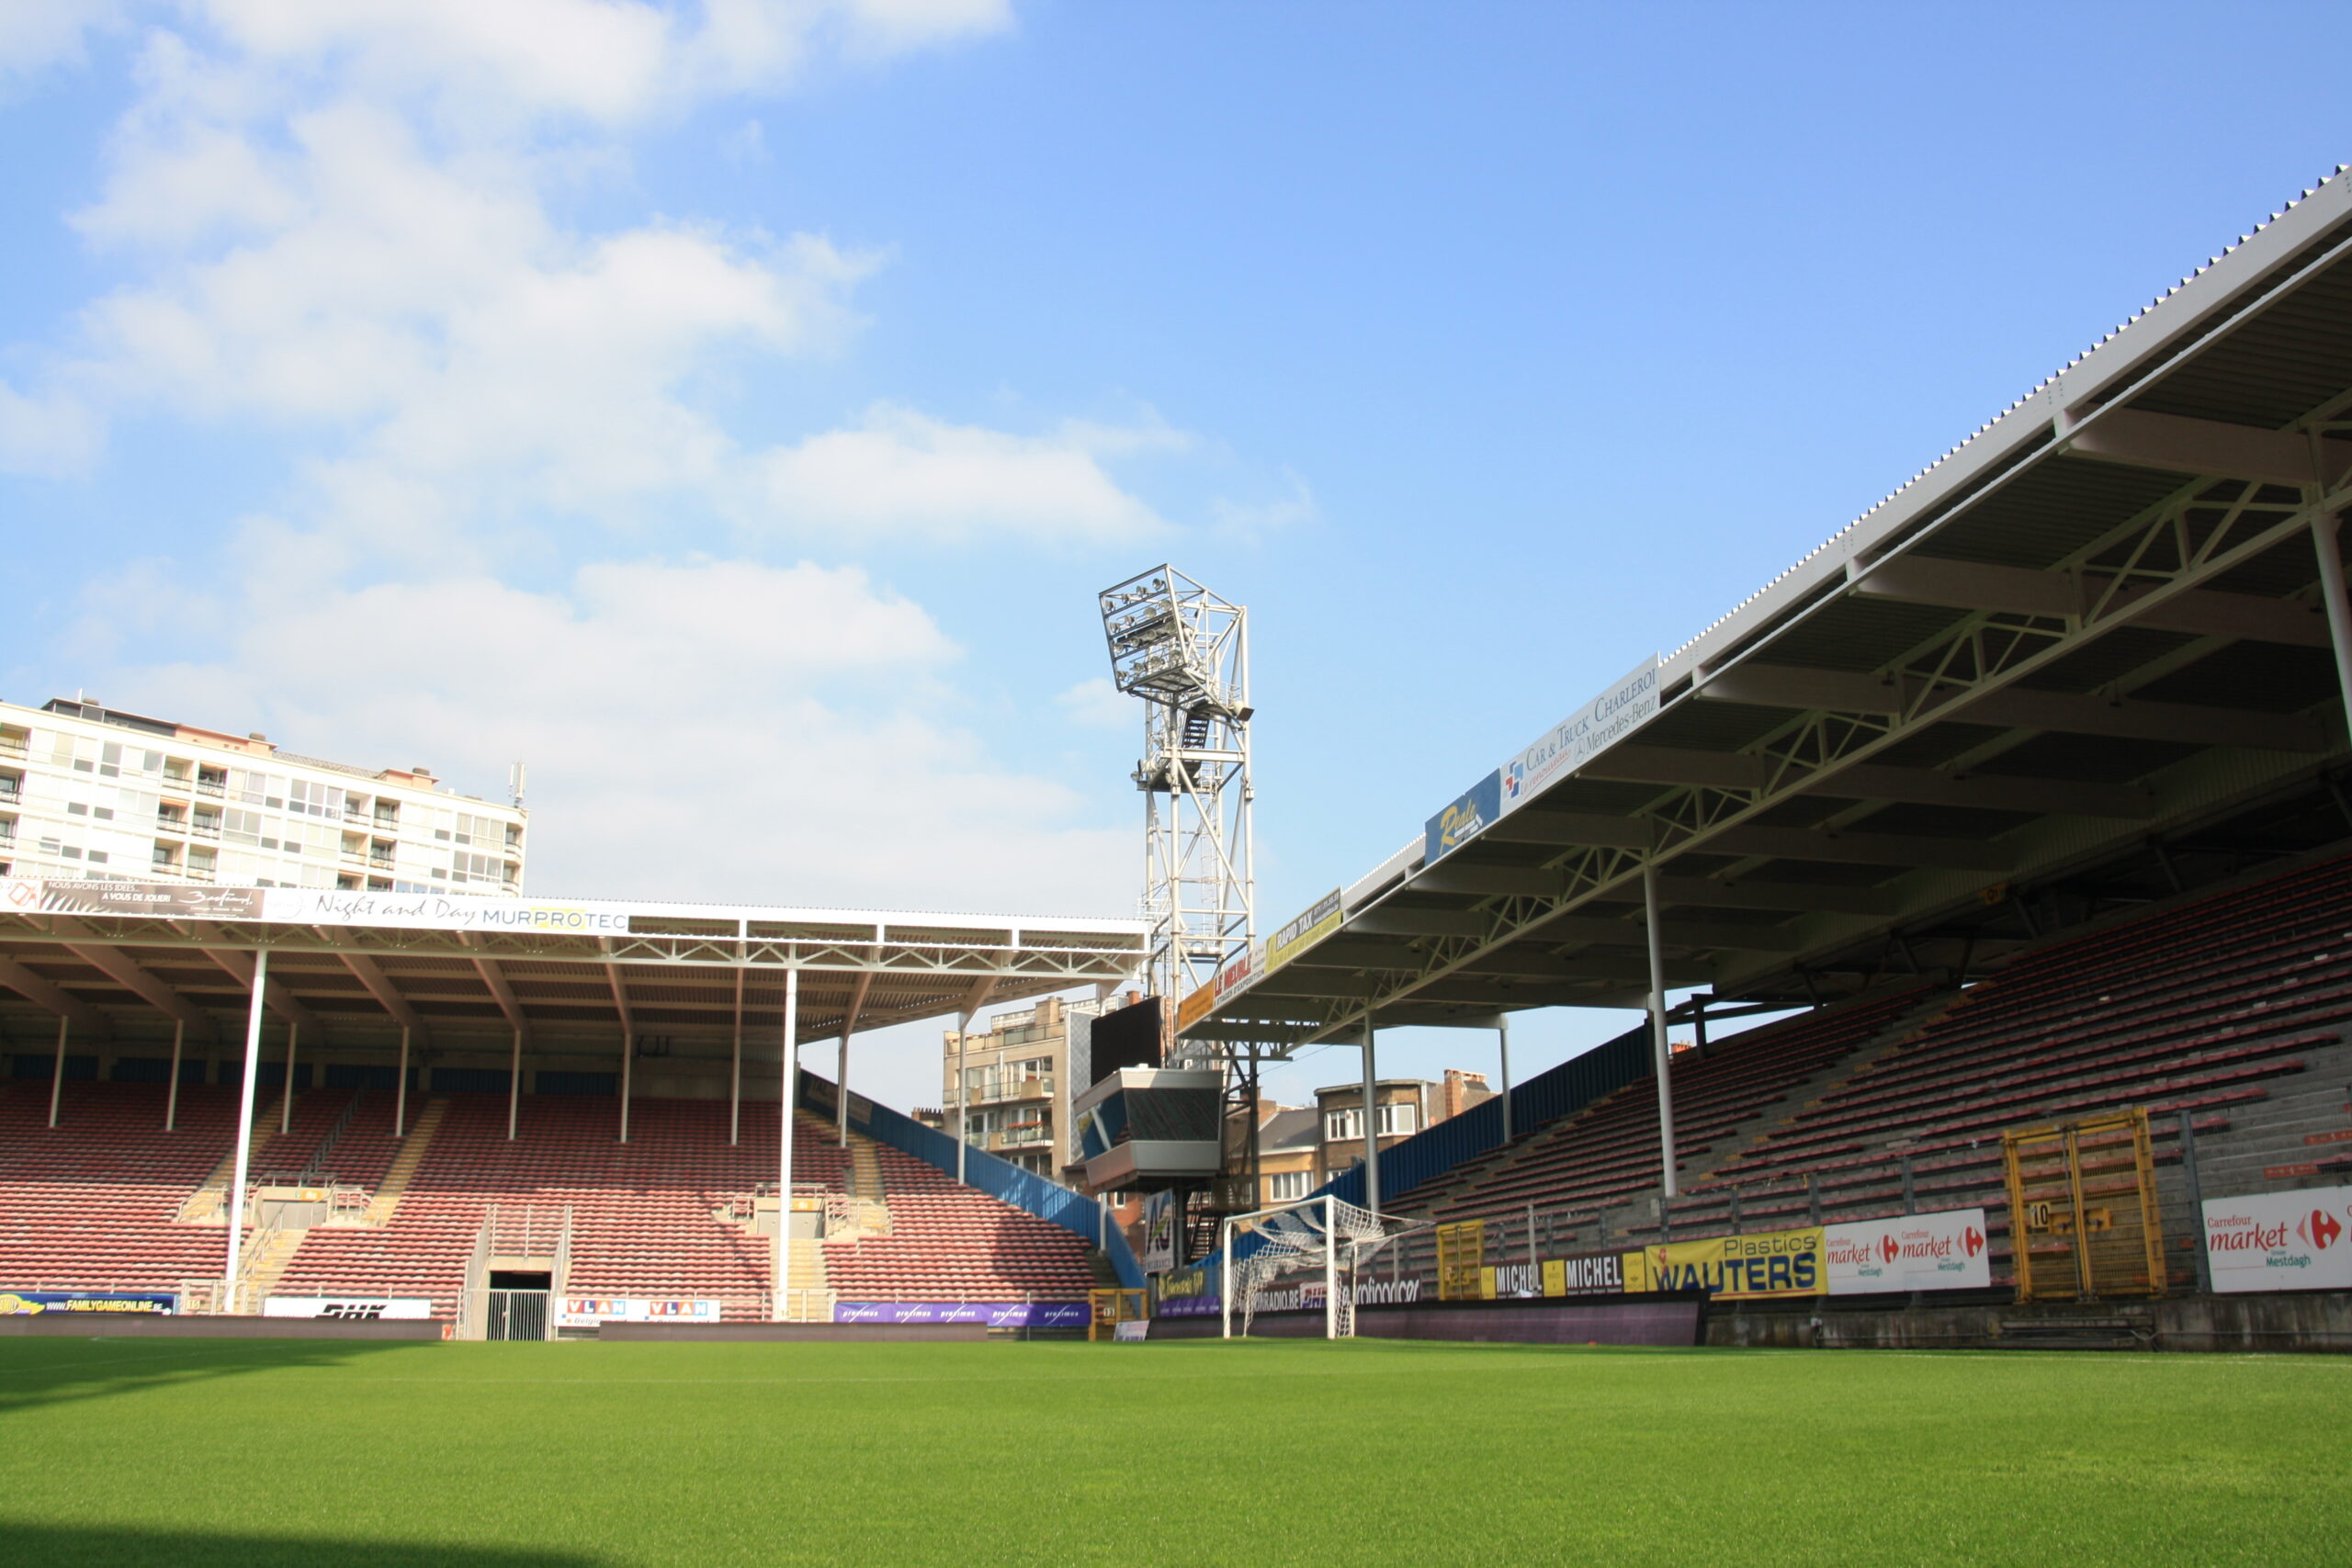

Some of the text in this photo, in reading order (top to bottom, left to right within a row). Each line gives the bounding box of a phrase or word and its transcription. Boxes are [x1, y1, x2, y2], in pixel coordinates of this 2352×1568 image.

[1586, 695, 1657, 754] Mercedes-Benz
[49, 881, 70, 891] NOUS
[71, 883, 98, 893] AVONS
[99, 885, 115, 894] LES
[110, 893, 130, 902] VOUS
[131, 894, 143, 903] DE
[315, 894, 477, 925] Night and Day
[482, 909, 628, 930] MURPROTEC
[1277, 924, 1297, 950] RAPID
[1298, 909, 1313, 932] TAX
[2031, 1204, 2048, 1225] 10
[2207, 1215, 2252, 1229] Carrefour
[1724, 1234, 1816, 1258] Plastics
[1902, 1235, 1951, 1259] market
[2209, 1223, 2290, 1252] market
[1826, 1244, 1871, 1265] market
[2265, 1254, 2312, 1269] Mestdagh
[1566, 1256, 1623, 1288] MICHEL
[1653, 1252, 1816, 1292] WAUTERS
[568, 1300, 626, 1314] VLAN
[650, 1301, 708, 1315] VLAN
